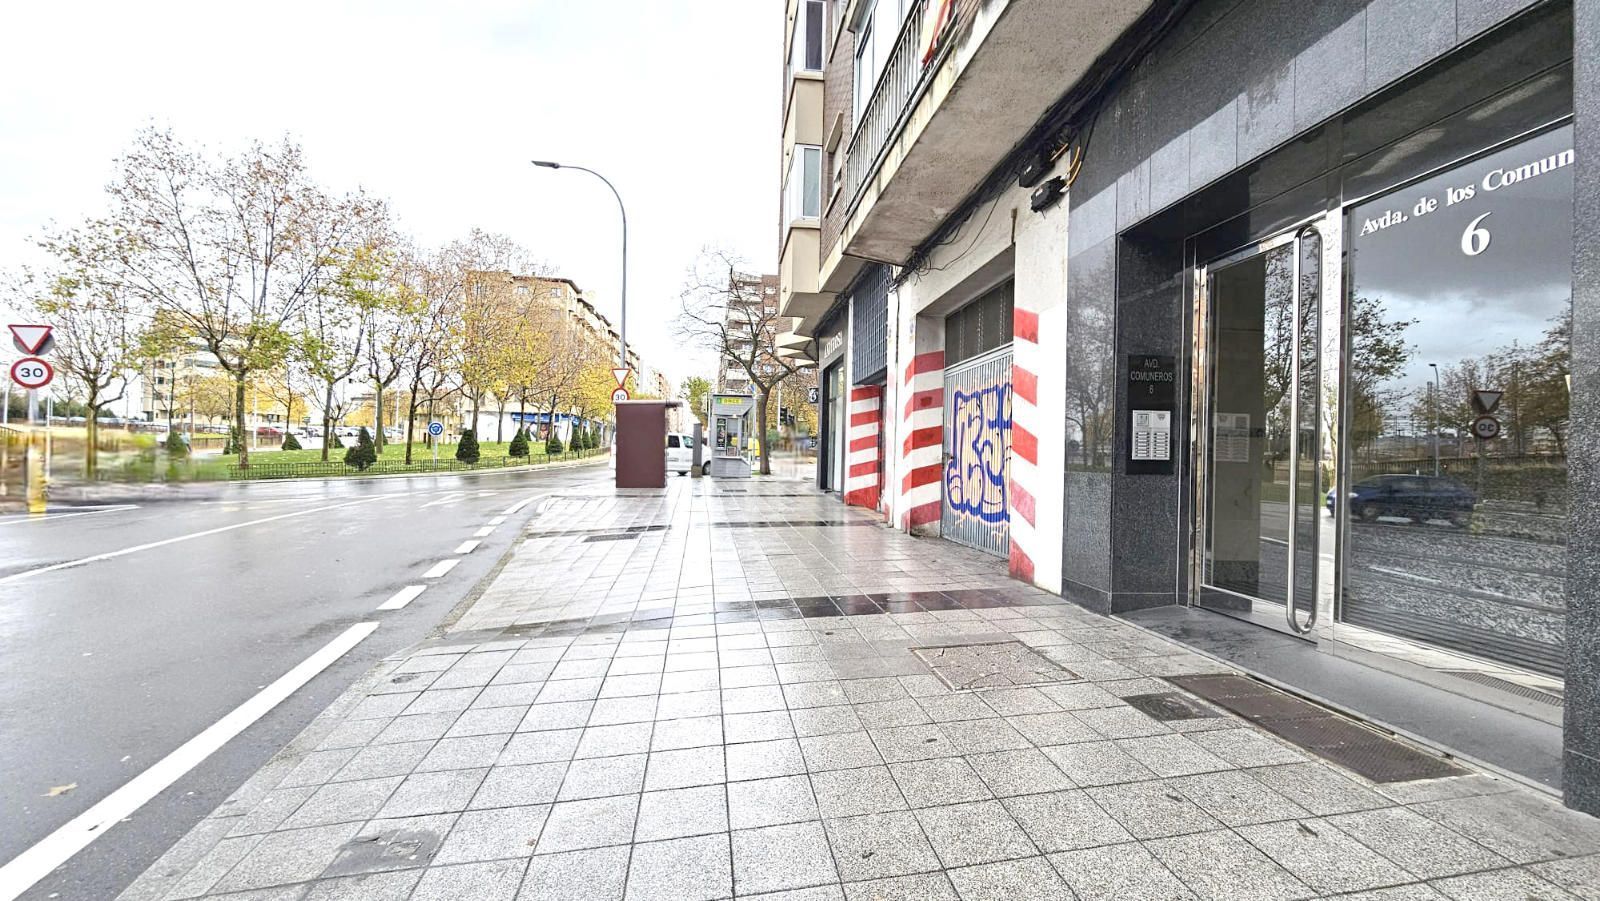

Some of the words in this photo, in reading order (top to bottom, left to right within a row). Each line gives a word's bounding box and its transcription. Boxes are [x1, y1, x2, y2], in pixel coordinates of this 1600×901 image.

[1359, 209, 1409, 237] Avda.
[1413, 197, 1438, 217] de
[1446, 187, 1475, 207] los
[1482, 149, 1575, 192] Comun
[1461, 211, 1492, 256] 6
[20, 367, 44, 378] 30
[1130, 370, 1173, 382] COMUNEROS
